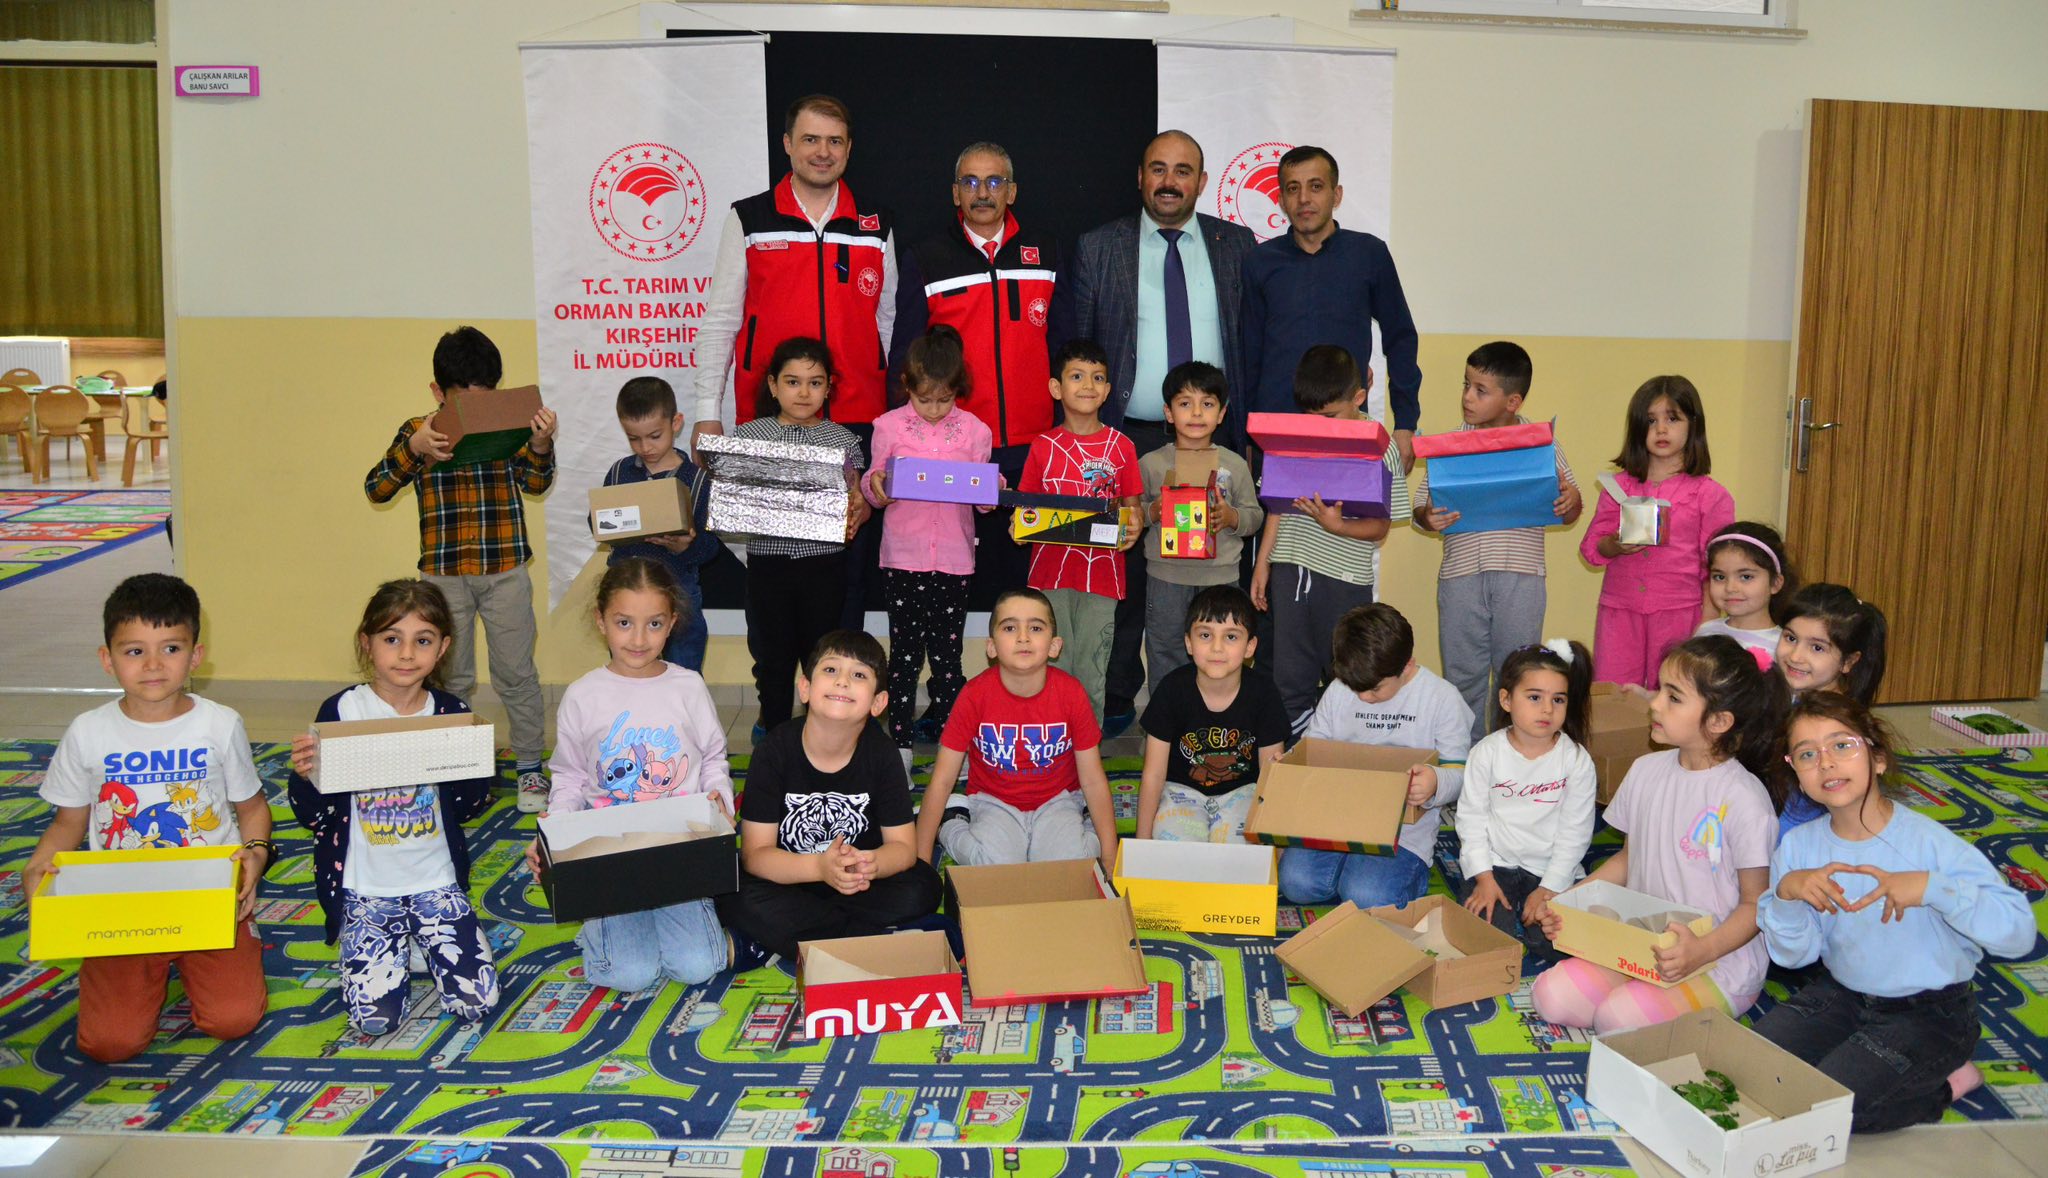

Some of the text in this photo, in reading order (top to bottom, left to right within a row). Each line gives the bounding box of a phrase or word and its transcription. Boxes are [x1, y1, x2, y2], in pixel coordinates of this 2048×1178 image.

[189, 72, 248, 82] ÇALIŞKAN ARILAR
[582, 278, 618, 295] T.C.
[623, 277, 689, 294] TARIM
[554, 303, 633, 320] ORMAN
[574, 350, 591, 369] İL
[1355, 712, 1379, 721] ATHLETIC
[598, 710, 681, 763] Lovely
[103, 748, 208, 773] SONIC
[107, 770, 206, 784] THE HEDGEHOG
[369, 806, 437, 838] WORD
[1202, 913, 1261, 925] GREYDER
[87, 925, 182, 940] mammamia
[1617, 956, 1661, 983] Polaris
